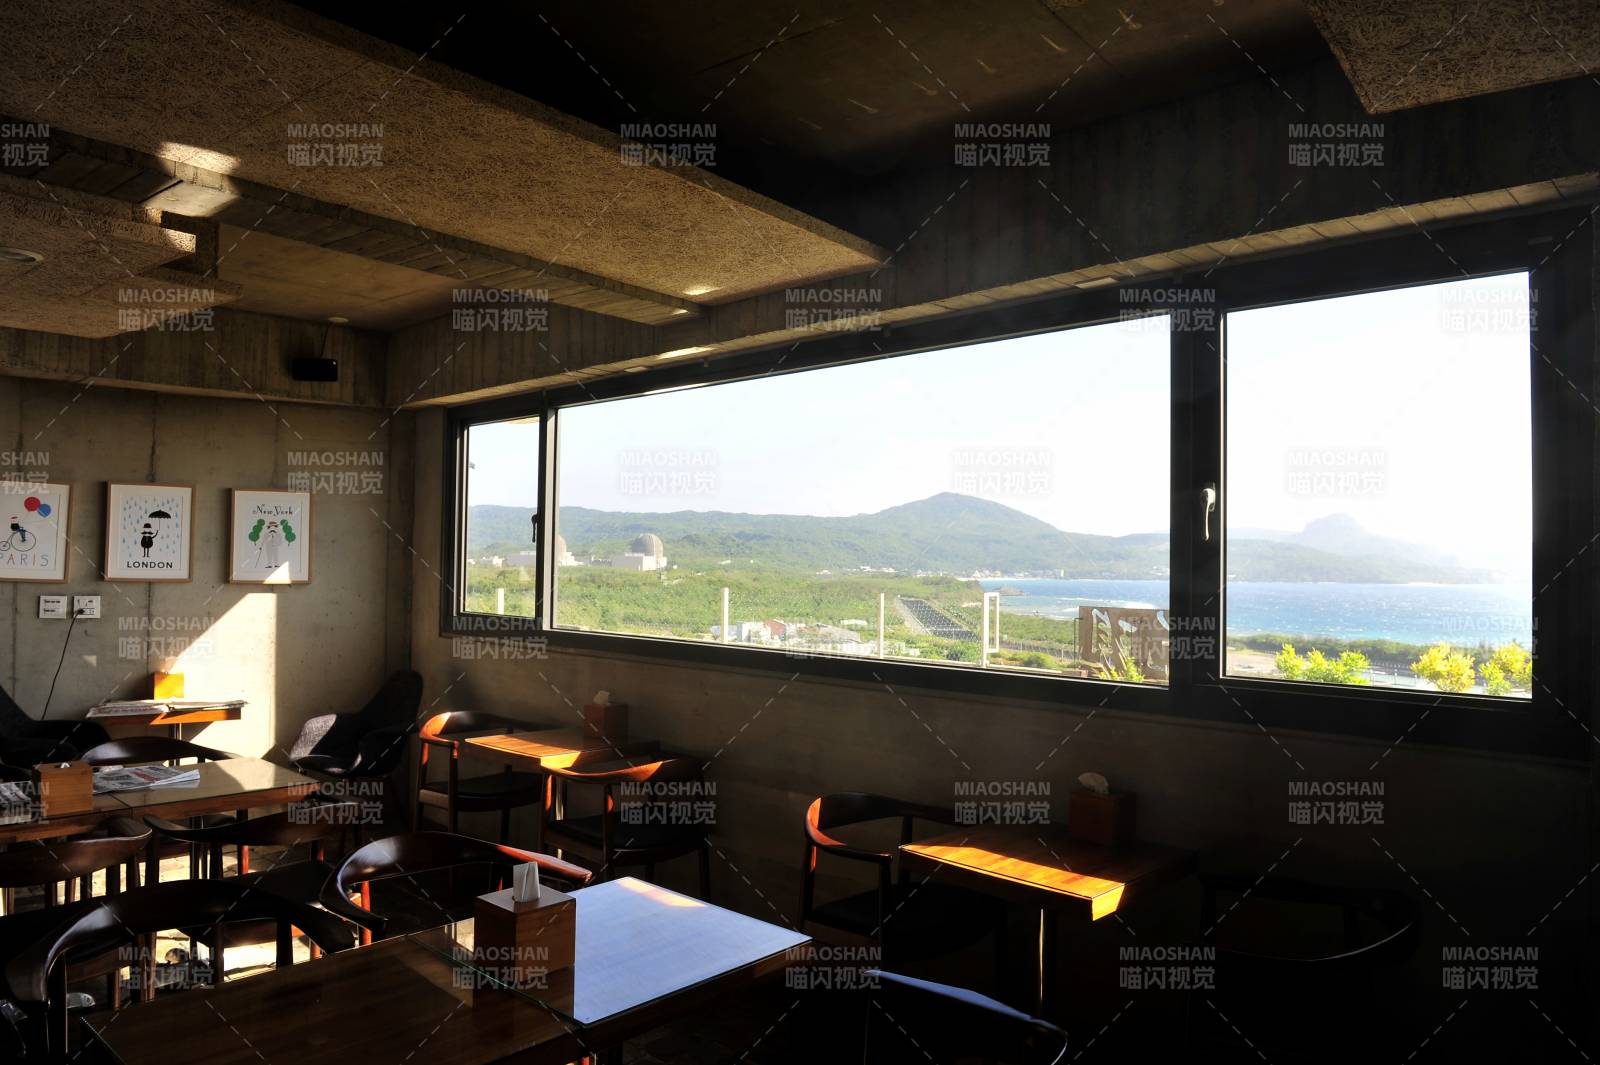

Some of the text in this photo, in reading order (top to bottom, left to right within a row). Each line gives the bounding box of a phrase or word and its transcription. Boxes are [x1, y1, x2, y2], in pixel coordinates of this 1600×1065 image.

[252, 503, 293, 517] New York
[126, 561, 174, 569] LONDON
